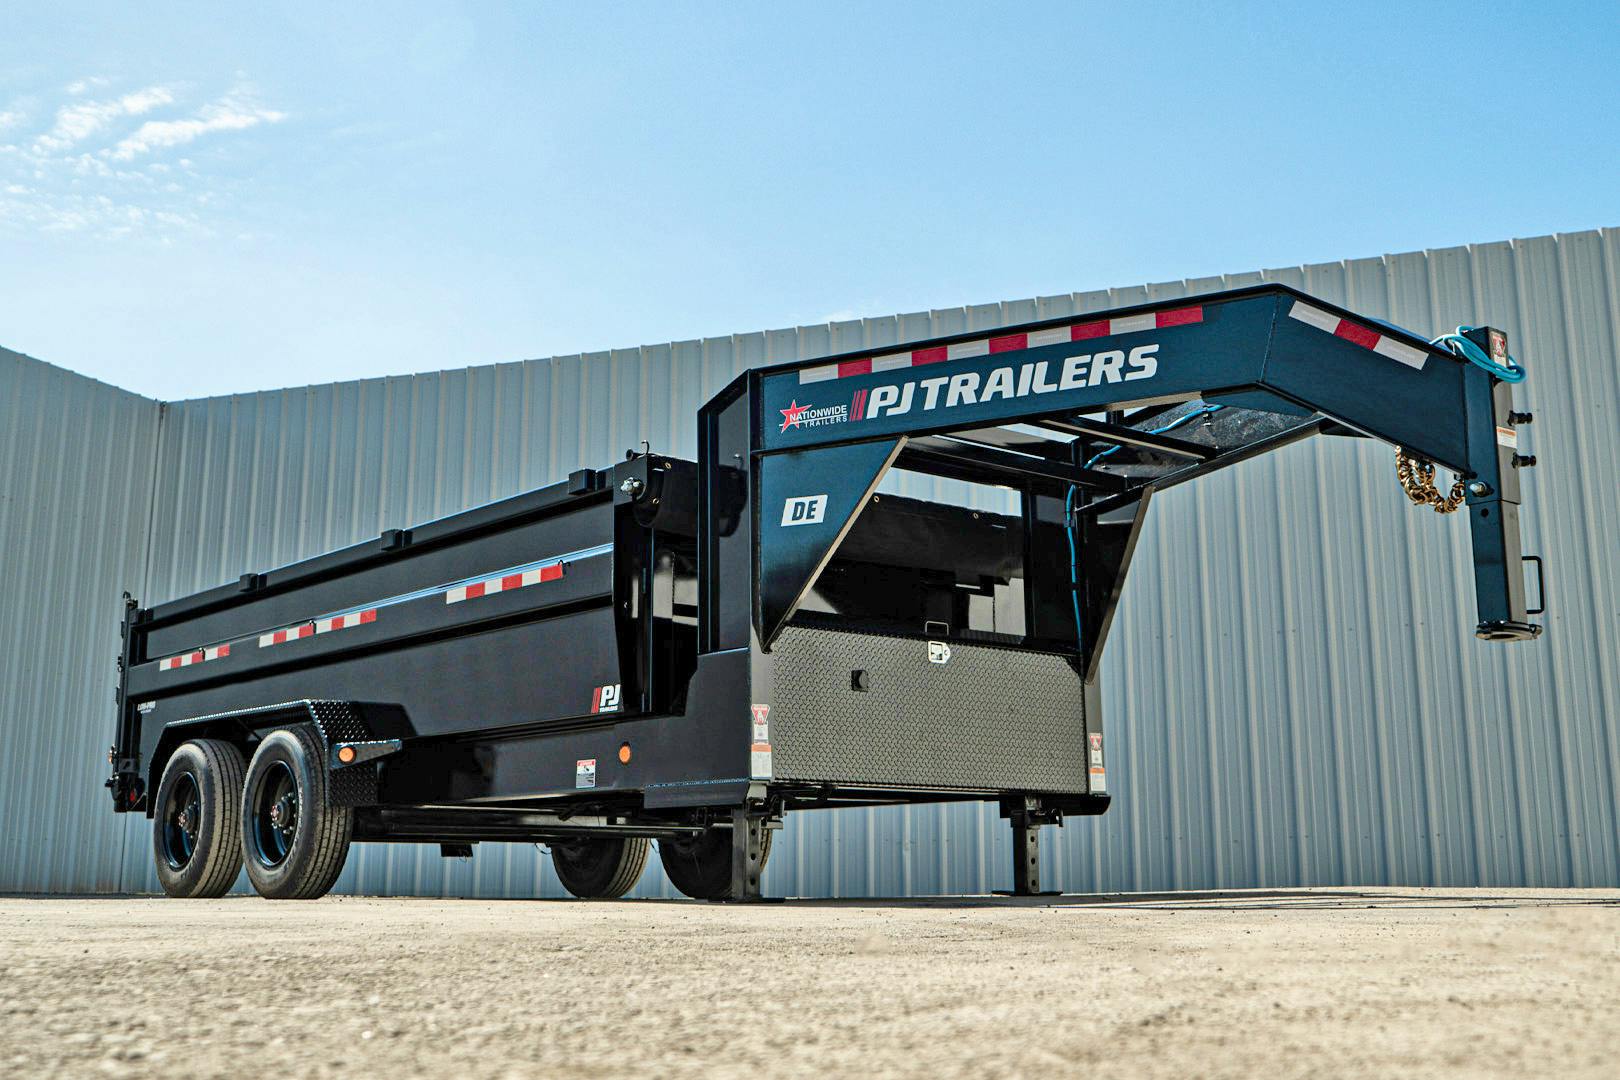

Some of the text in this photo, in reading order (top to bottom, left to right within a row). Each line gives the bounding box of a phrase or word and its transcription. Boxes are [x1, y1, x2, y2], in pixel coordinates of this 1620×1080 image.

[866, 344, 1160, 419] PJ TRAILERS
[789, 404, 848, 421] NATIONWIDE
[804, 415, 848, 428] TRAILERS
[791, 499, 819, 521] DE
[600, 684, 621, 707] PJ
